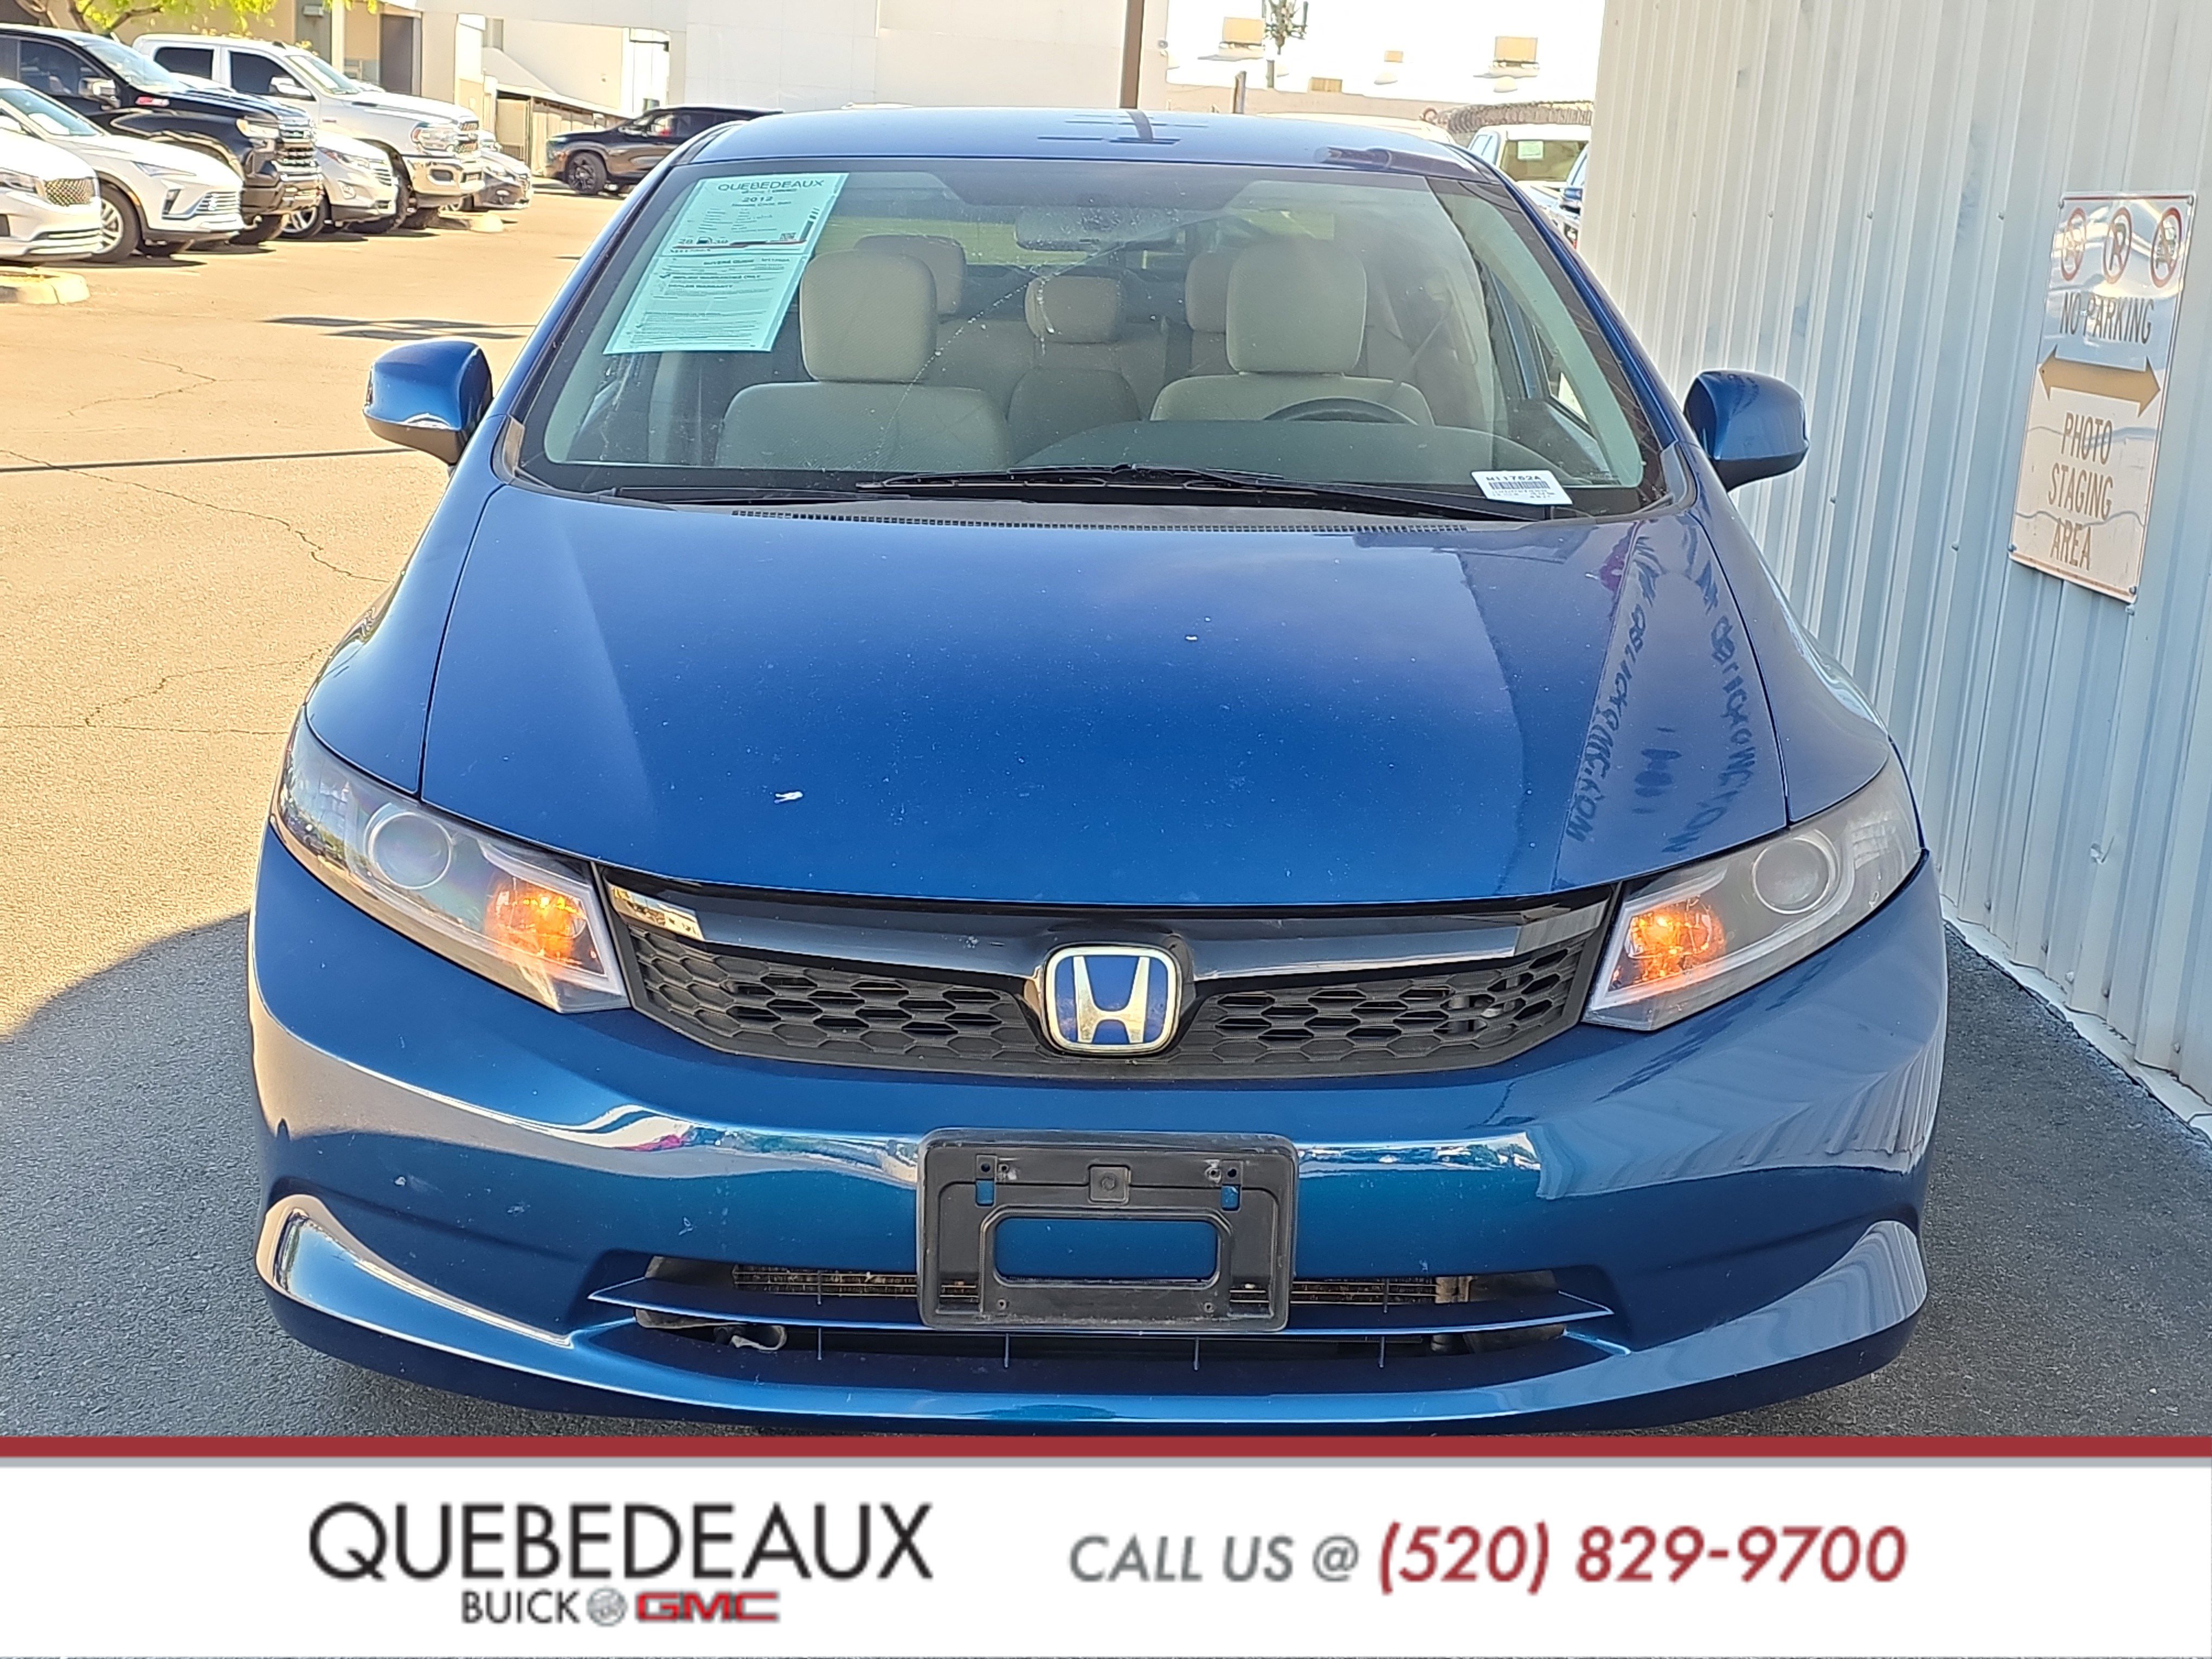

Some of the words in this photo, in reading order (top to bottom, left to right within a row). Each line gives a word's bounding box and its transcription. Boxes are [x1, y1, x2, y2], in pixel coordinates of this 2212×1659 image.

[717, 179, 825, 190] QUEBEDEAUX
[2060, 291, 2082, 336] NO
[2083, 293, 2155, 345] PARKING
[2060, 411, 2113, 465] PHOTO
[2048, 462, 2113, 520] STAGING
[2049, 517, 2092, 571] AREA
